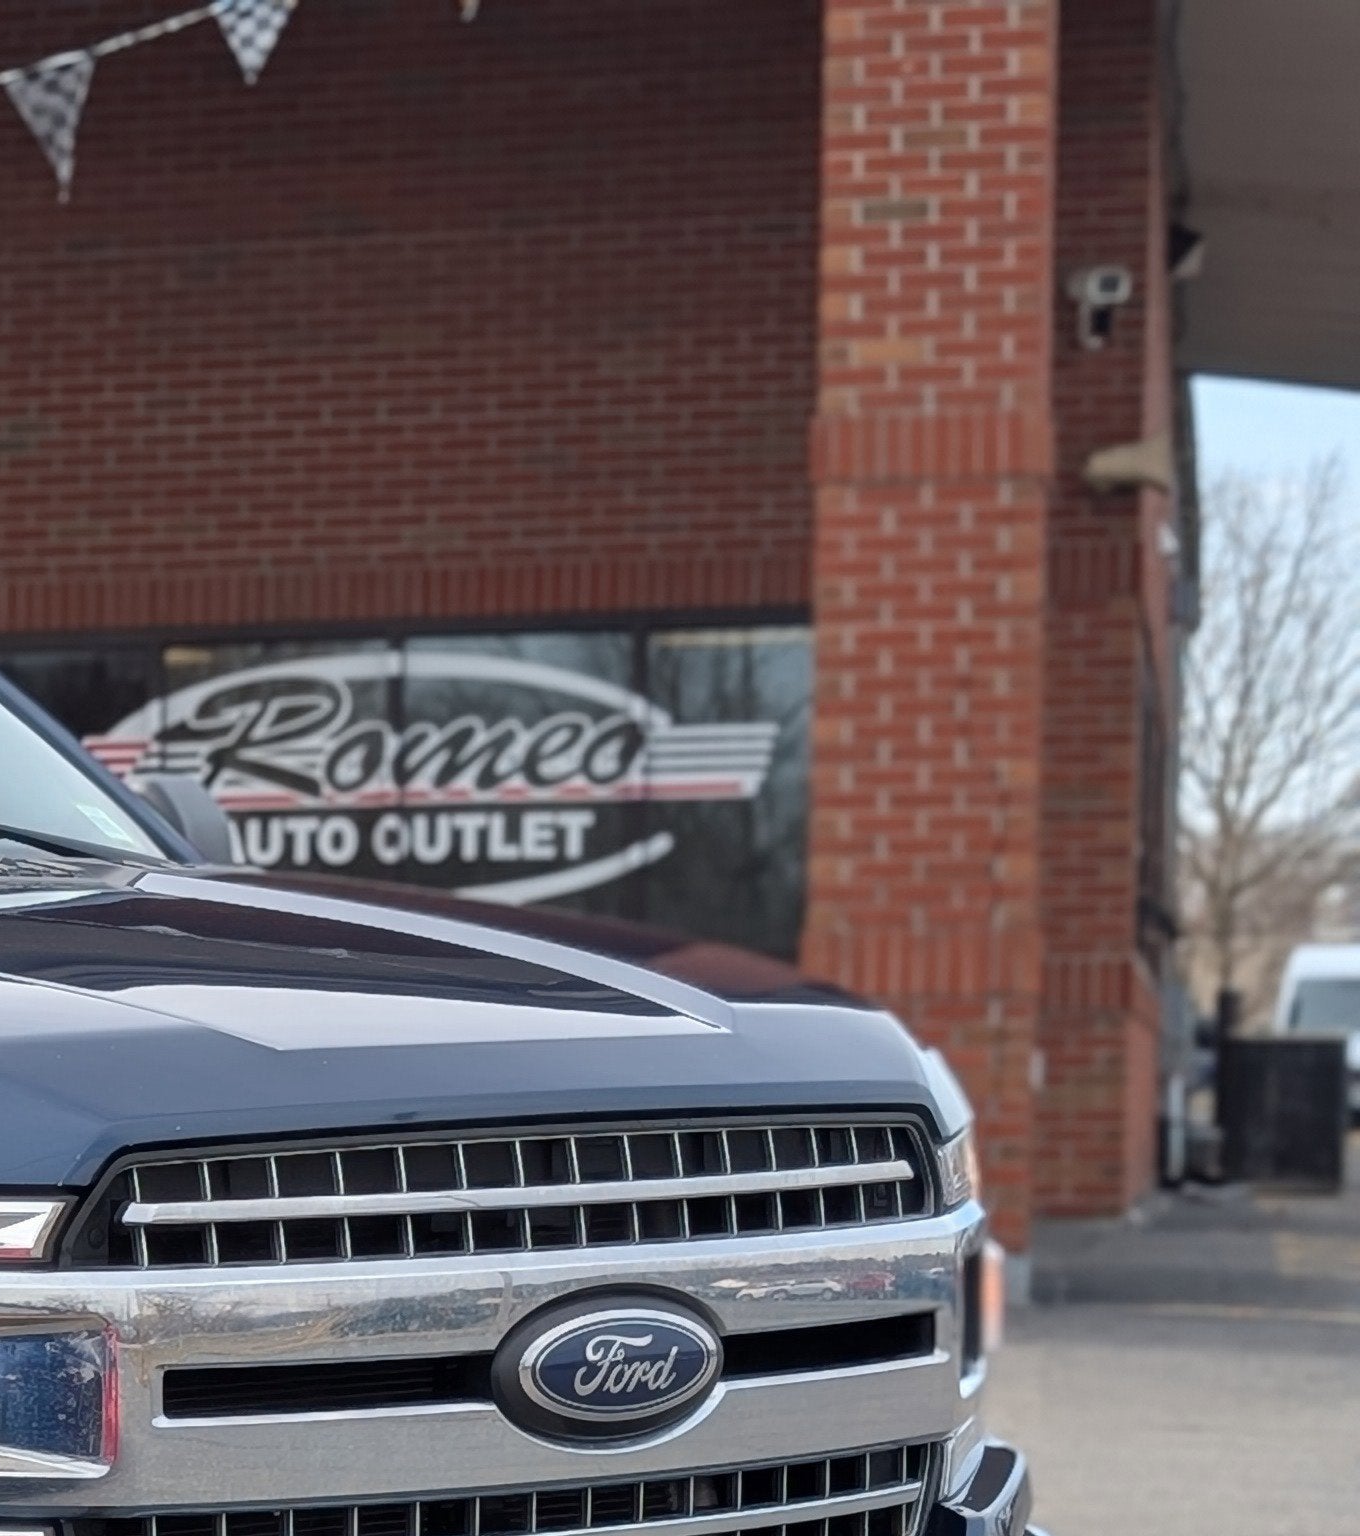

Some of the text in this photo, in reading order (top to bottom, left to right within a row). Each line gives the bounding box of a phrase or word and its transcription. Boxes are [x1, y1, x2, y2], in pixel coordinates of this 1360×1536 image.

[150, 674, 646, 798] Romeo
[370, 809, 597, 866] OUTLET
[573, 1333, 679, 1397] Ford
